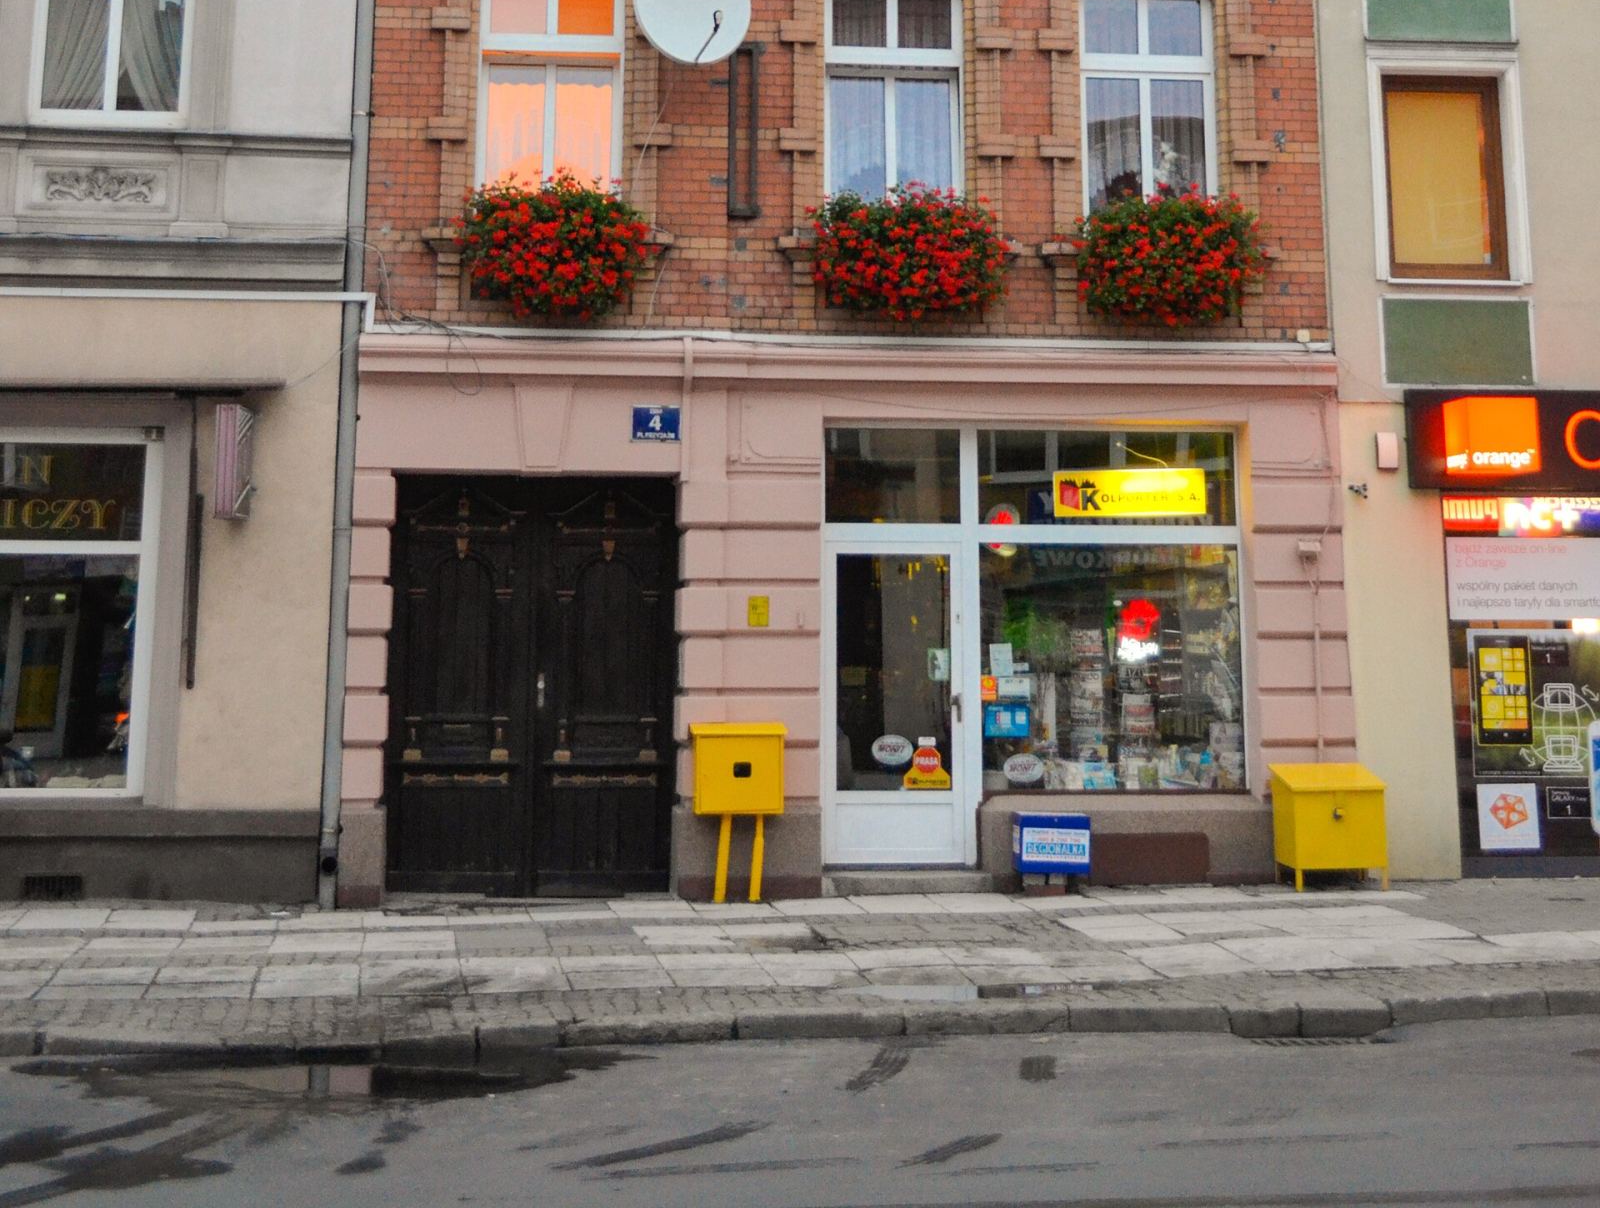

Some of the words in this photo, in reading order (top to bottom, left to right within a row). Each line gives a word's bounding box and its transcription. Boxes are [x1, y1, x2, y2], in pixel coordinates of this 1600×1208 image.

[648, 415, 662, 431] 4
[1472, 451, 1531, 469] orange
[1465, 557, 1507, 570] Orange
[1539, 580, 1578, 593] danych
[1545, 596, 1560, 607] dla
